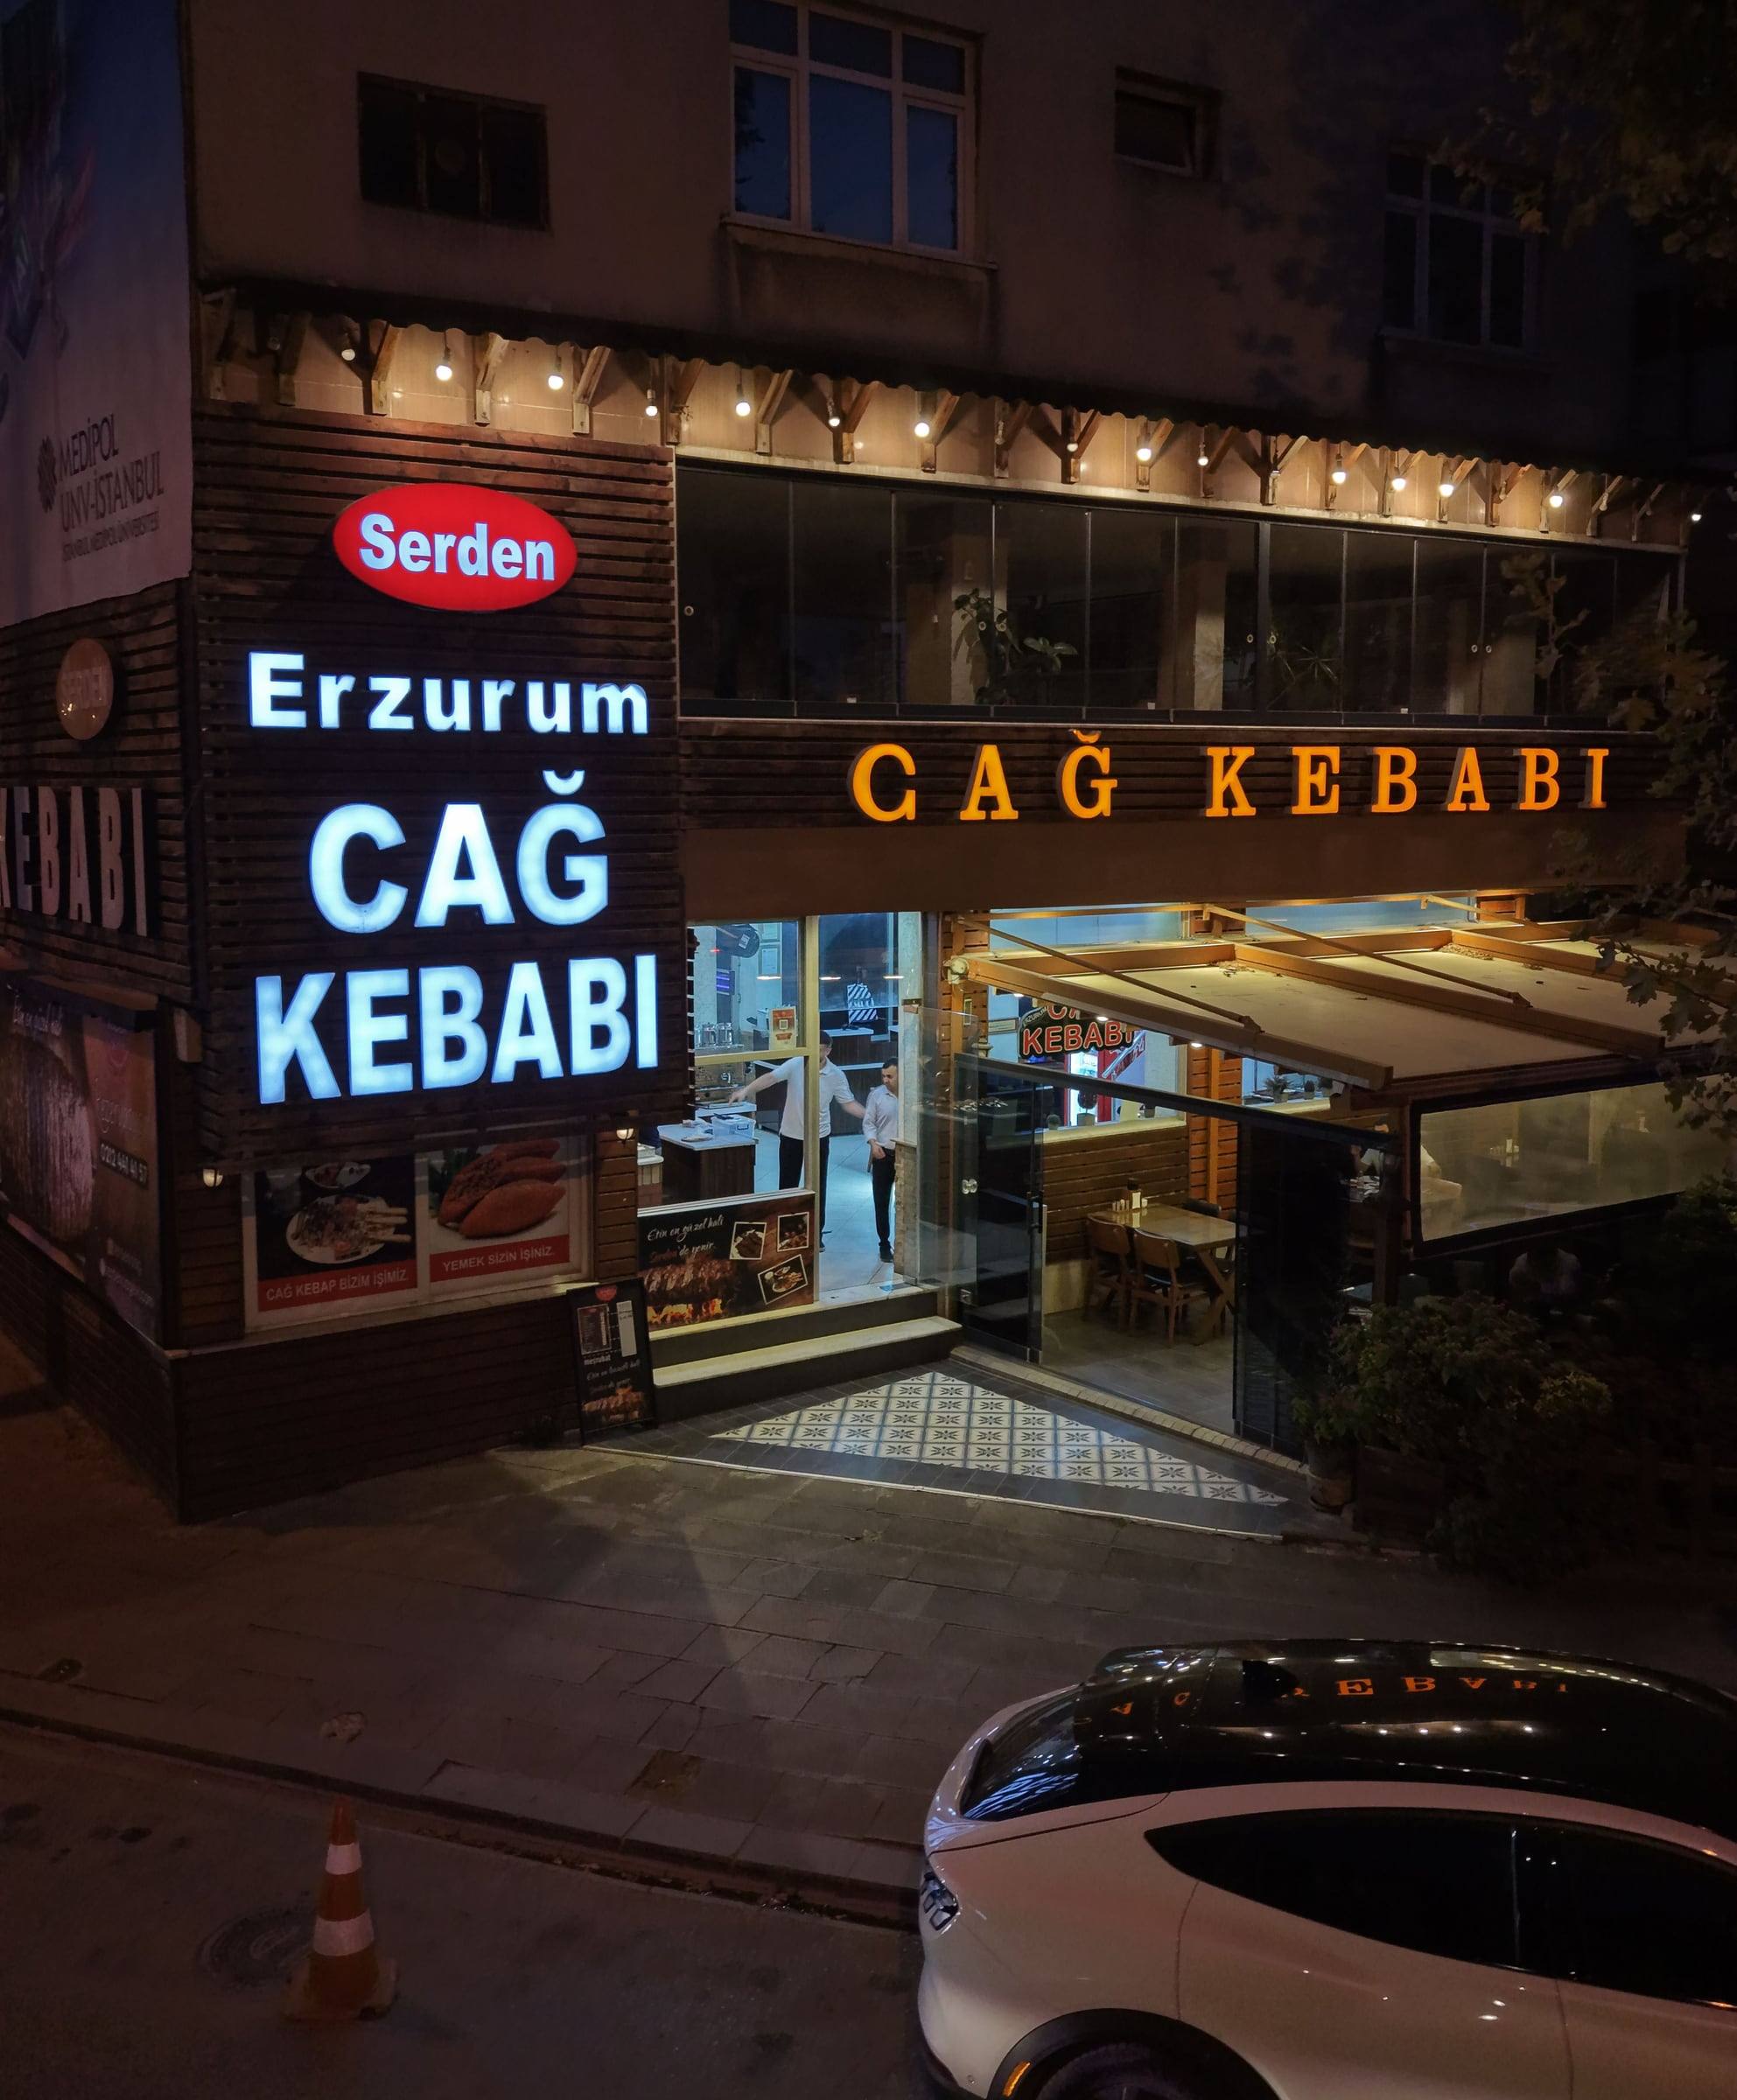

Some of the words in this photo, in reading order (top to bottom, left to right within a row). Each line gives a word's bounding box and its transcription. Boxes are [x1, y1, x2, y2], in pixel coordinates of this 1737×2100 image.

[58, 414, 119, 480] MEDİPOL
[359, 513, 556, 581] Serden
[248, 651, 649, 734] Erzurum
[851, 729, 1117, 822] CAĞ
[1204, 746, 1609, 818] KEBABI
[309, 769, 609, 934] CAĞ
[255, 954, 659, 1104] KEBABI
[266, 1283, 293, 1301] CAĞ
[296, 1278, 337, 1298] KEBAP
[339, 1273, 370, 1292] BİZİM
[442, 1255, 485, 1272] YEMEK
[488, 1251, 517, 1266] SİZİN
